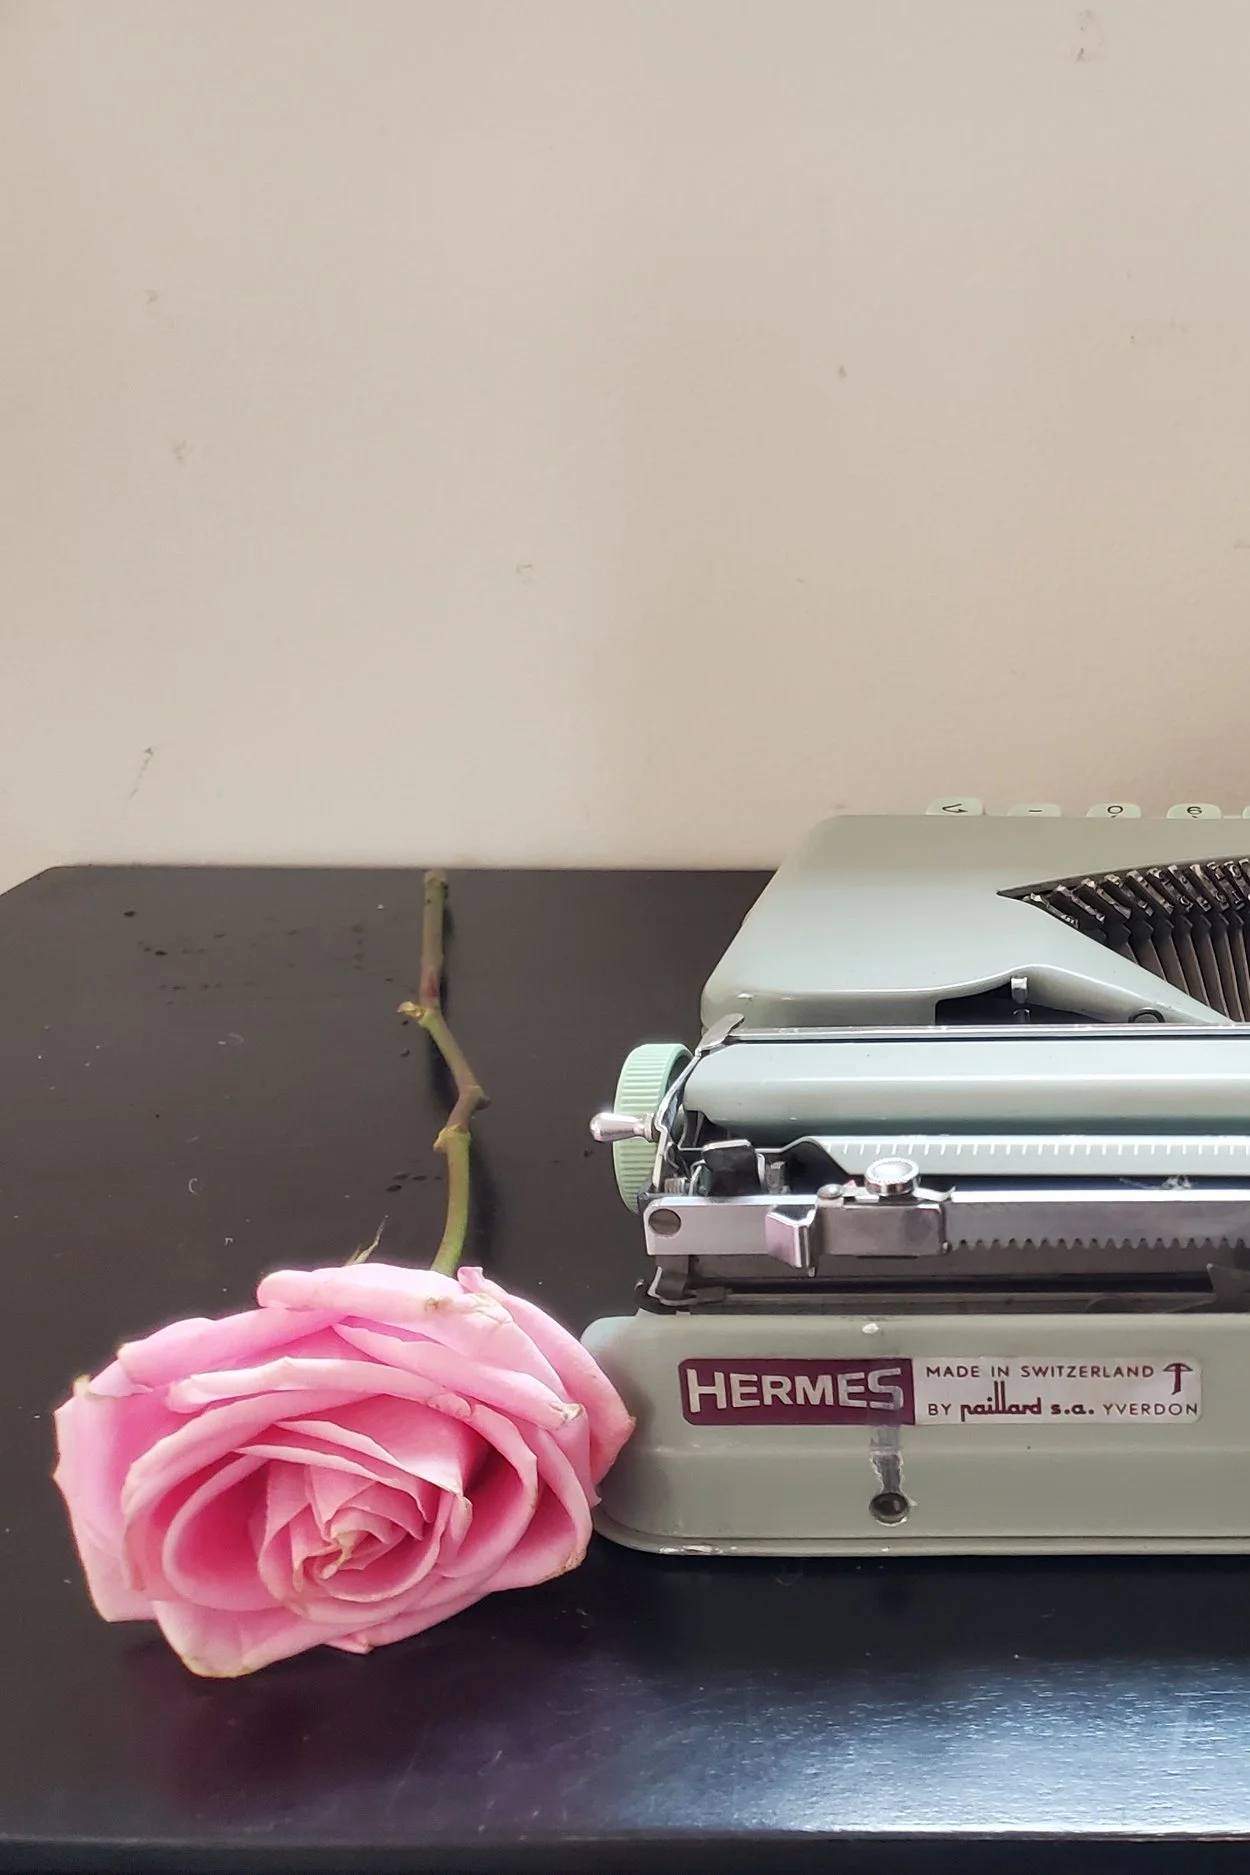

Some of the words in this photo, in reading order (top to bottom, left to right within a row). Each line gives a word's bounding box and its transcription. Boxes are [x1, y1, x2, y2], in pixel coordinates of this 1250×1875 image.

[686, 1367, 904, 1413] HERMES
[926, 1365, 980, 1378] MADE
[991, 1365, 1010, 1378] IN
[1020, 1365, 1154, 1378] SWITZERLAND
[928, 1403, 952, 1416] BY
[960, 1380, 1042, 1422] paillard
[1050, 1403, 1094, 1415] s.a.
[1102, 1403, 1198, 1416] YVERDON
